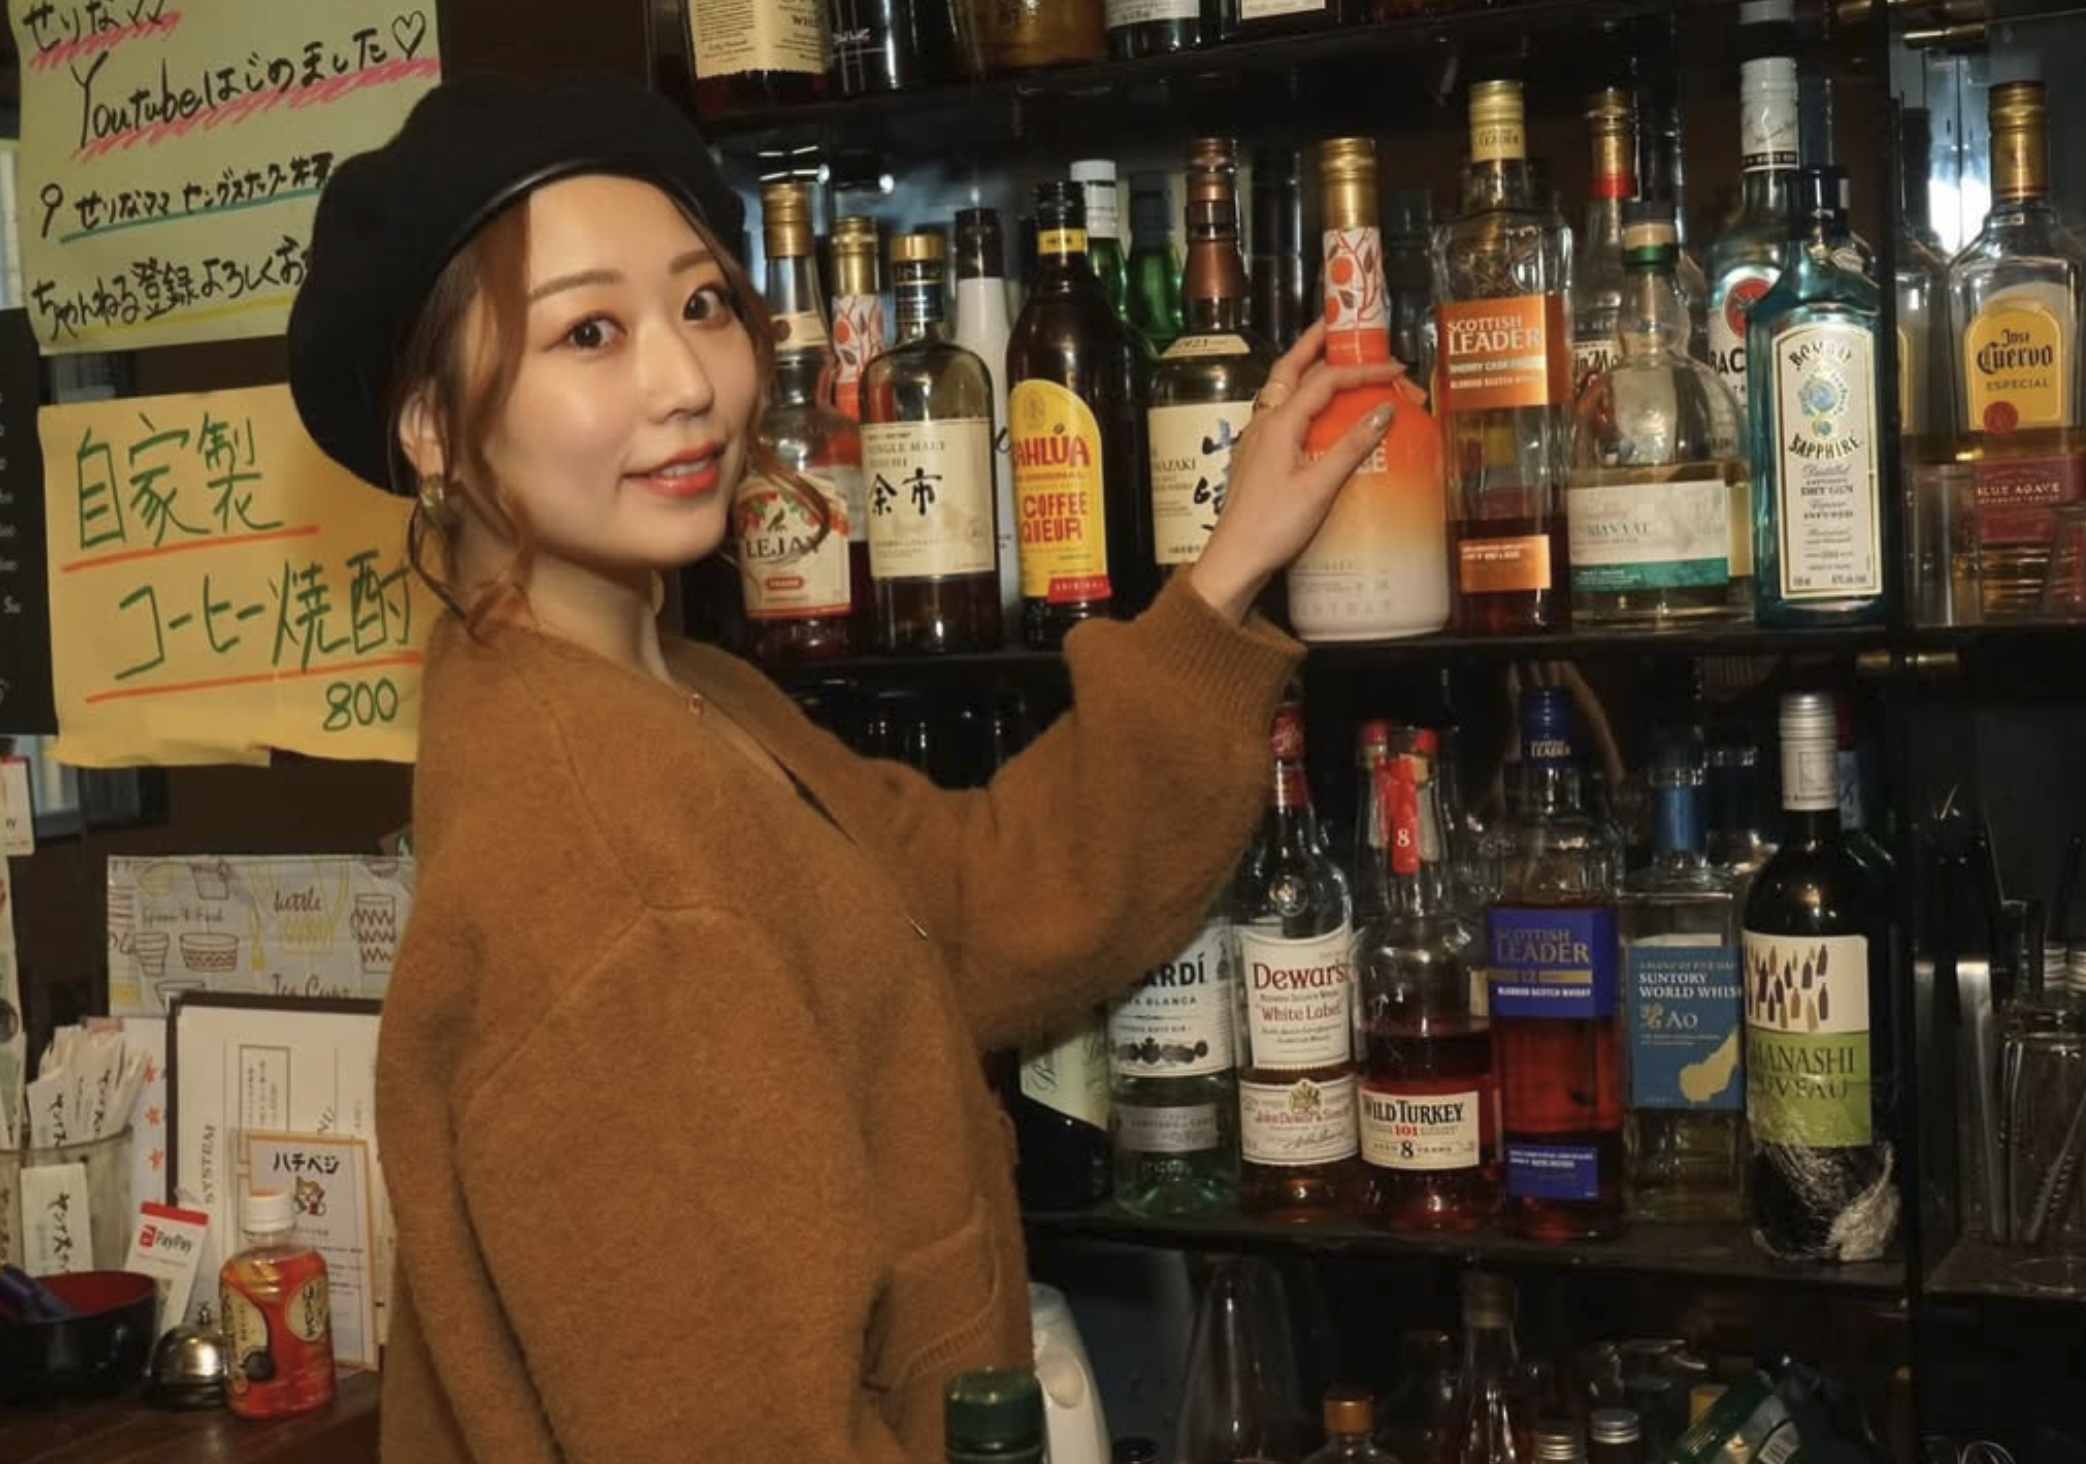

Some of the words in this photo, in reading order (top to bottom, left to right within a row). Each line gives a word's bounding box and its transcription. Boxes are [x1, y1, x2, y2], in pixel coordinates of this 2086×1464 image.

[1447, 315, 1523, 333] SCOTTISH
[1449, 328, 1542, 356] LEADER
[2001, 328, 2031, 348] Jose
[1976, 341, 2054, 375] Cuervo
[1986, 378, 2050, 391] ESPECIAL
[1788, 432, 1861, 460] SAPPHIRE
[77, 412, 284, 549] 自家製
[869, 466, 944, 517] 余市
[1022, 491, 1089, 519] COFFEE
[1020, 517, 1083, 544] QUEUR
[114, 550, 411, 681] コーヒー焼酎
[323, 678, 398, 731] 800
[1397, 828, 1411, 847] 8
[1497, 942, 1590, 963] LEADER
[1637, 972, 1707, 984] SUNTORY
[1638, 985, 1694, 998] WORLD
[1262, 1005, 1305, 1021] White
[1306, 1001, 1342, 1020] Label
[1395, 1125, 1418, 1137] 101
[1401, 1140, 1415, 1159] 8
[156, 1228, 193, 1254] PayPay
